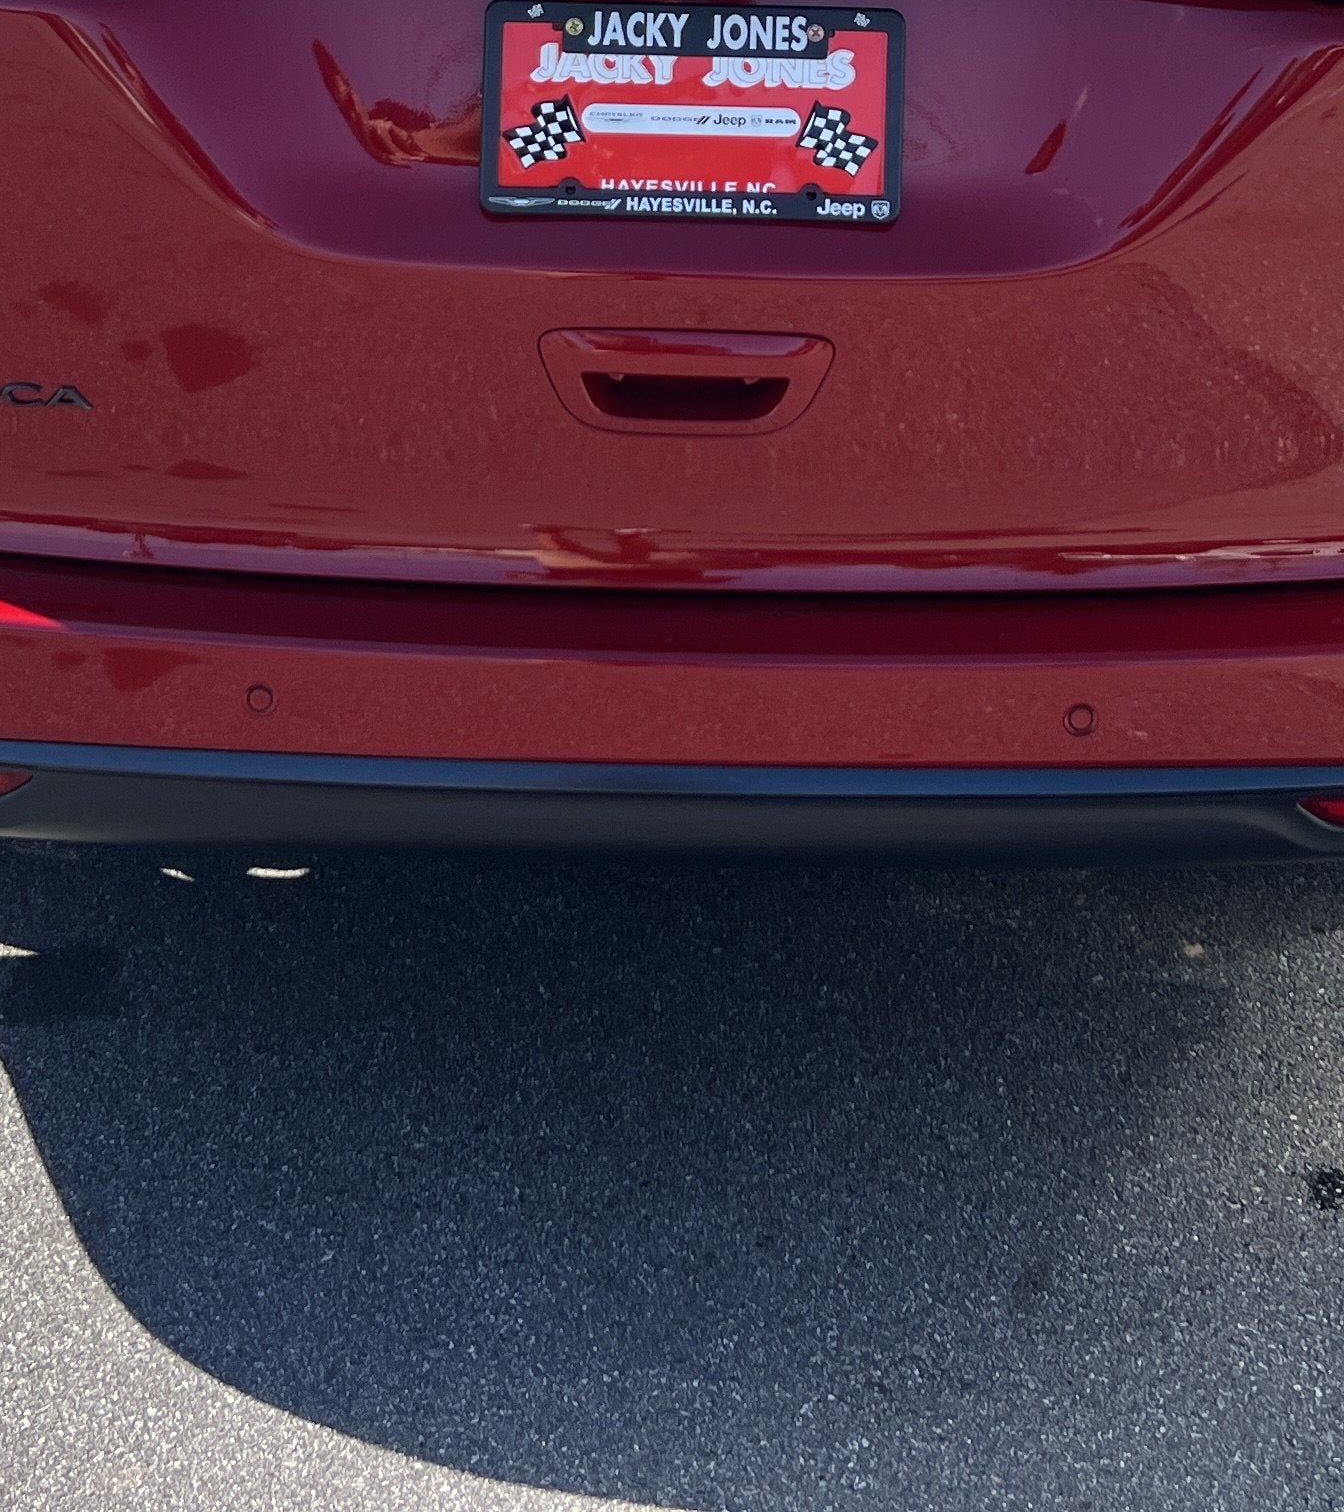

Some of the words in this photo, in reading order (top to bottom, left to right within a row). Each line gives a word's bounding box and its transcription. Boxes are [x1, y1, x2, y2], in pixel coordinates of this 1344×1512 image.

[587, 10, 690, 48] JACKY
[706, 13, 809, 52] JONES
[713, 113, 747, 128] Jeep
[625, 195, 738, 216] HAYESVILLE,
[742, 198, 778, 216] N.C.
[816, 197, 866, 220] Jeep
